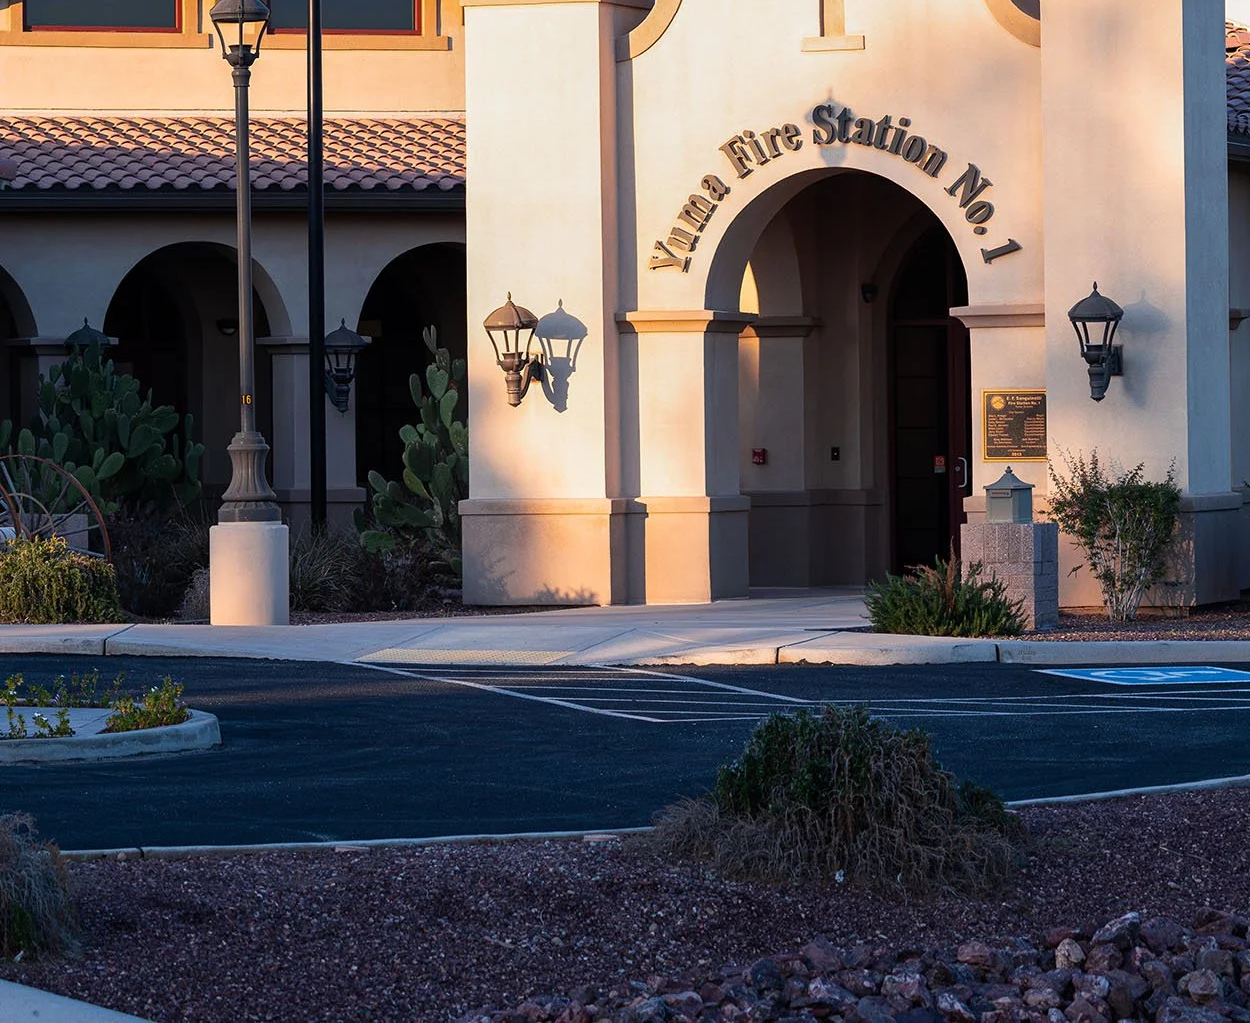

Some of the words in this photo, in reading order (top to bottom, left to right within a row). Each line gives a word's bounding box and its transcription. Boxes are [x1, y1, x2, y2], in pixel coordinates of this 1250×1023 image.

[648, 173, 731, 273] Yuma
[718, 121, 804, 180] Fire
[811, 103, 949, 179] Station
[943, 162, 996, 236] No.
[980, 237, 1024, 266] 1
[242, 394, 252, 405] 16
